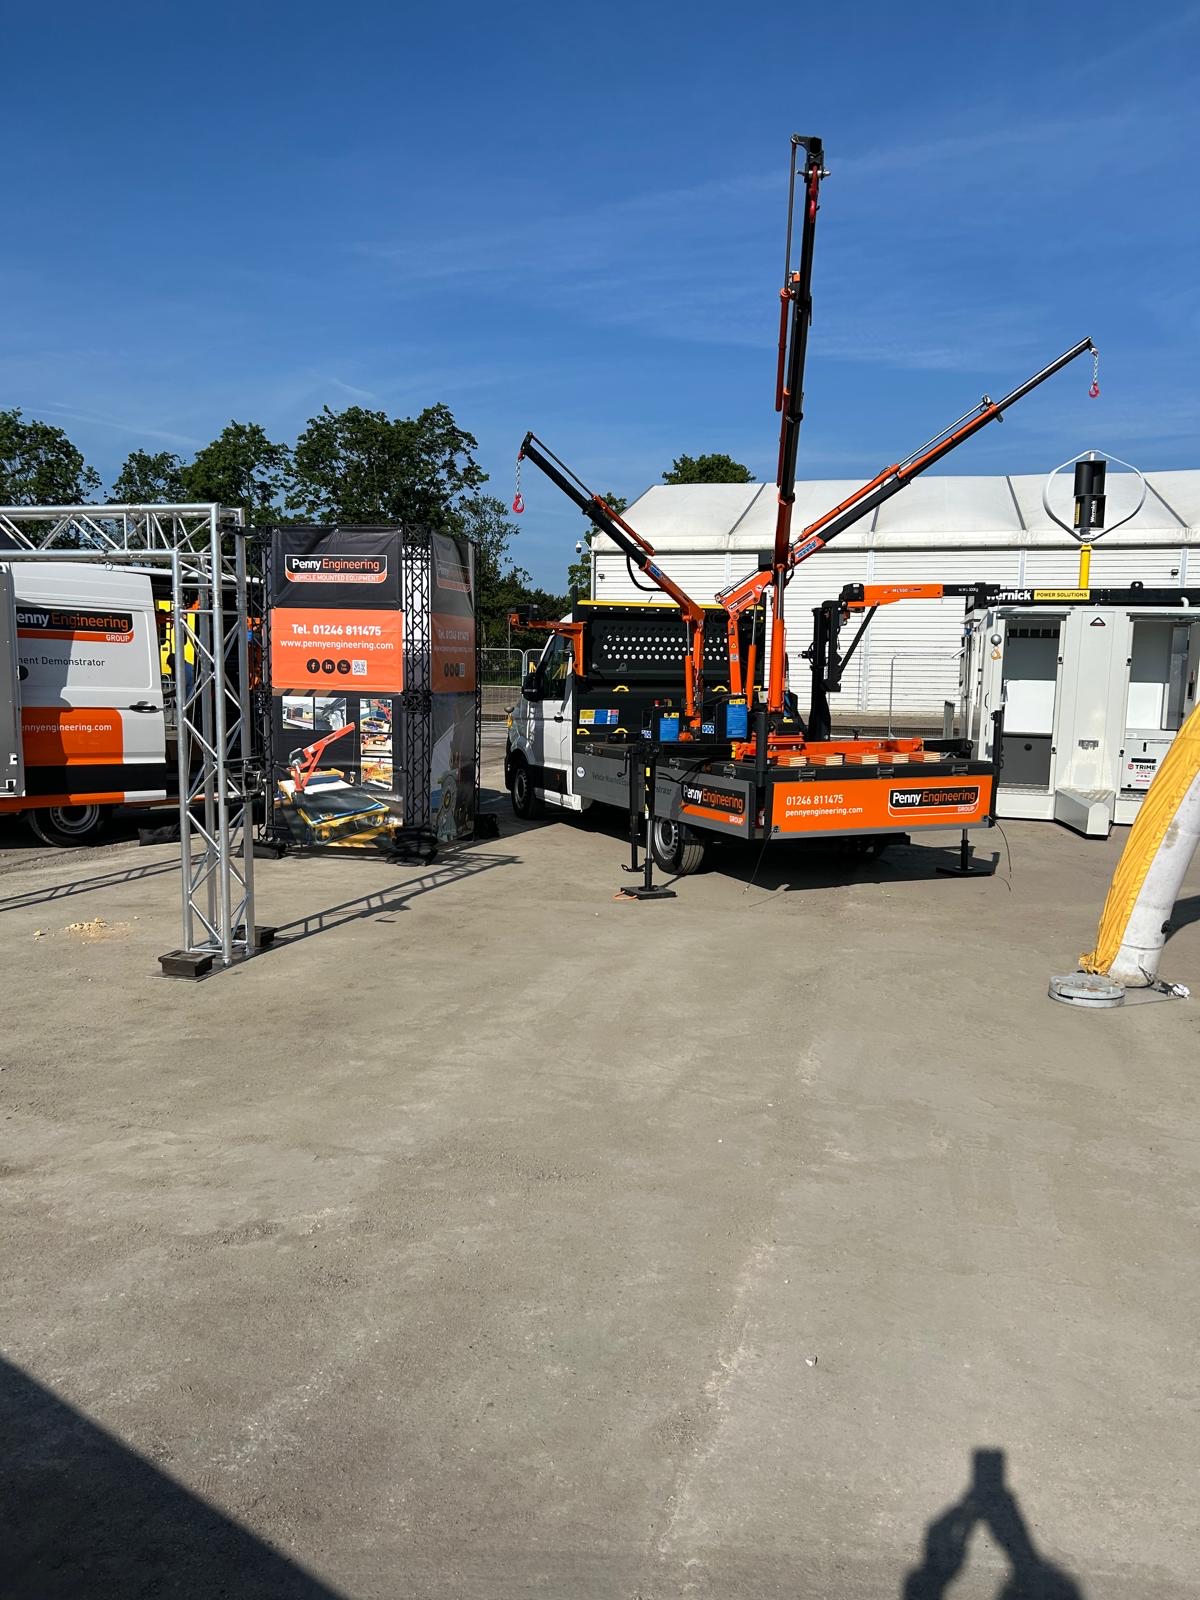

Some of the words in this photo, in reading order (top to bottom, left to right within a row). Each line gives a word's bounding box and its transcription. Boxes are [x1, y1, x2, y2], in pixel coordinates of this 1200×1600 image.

[292, 558, 321, 571] Penny
[322, 558, 380, 572] Engineering
[16, 612, 50, 627] enny
[51, 612, 129, 632] Engineering
[291, 624, 311, 635] Tel.
[313, 624, 343, 635] 01246
[346, 625, 382, 636] 811475
[105, 634, 130, 642] GROUP
[280, 640, 394, 651] www.pennyengineering.com
[41, 656, 106, 666] Demonstrator
[683, 784, 703, 804] Penny
[702, 788, 743, 813] Engineering
[786, 795, 812, 806] 01246
[813, 794, 844, 805] 811475
[892, 792, 921, 805] Penny
[922, 790, 976, 804] Engineering
[785, 807, 863, 818] pennyengineering.com
